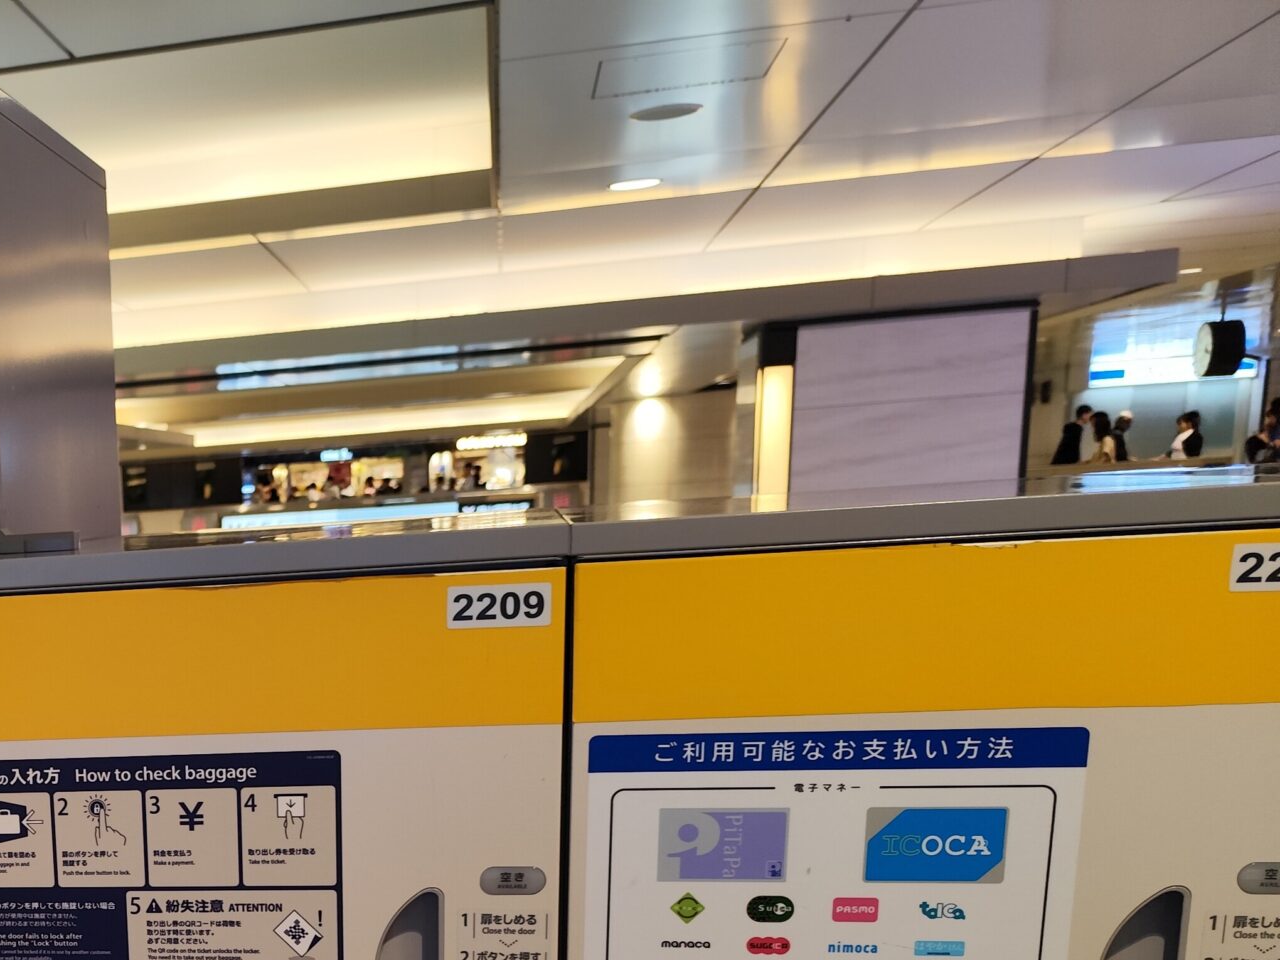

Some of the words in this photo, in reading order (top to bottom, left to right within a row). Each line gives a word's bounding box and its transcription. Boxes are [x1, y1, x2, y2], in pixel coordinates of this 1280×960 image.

[452, 590, 545, 621] 2209
[654, 737, 1015, 763] ご利用可能なお支払い方法
[75, 768, 111, 783] How
[114, 768, 131, 782] to
[135, 766, 181, 781] check
[185, 765, 257, 783] baggage
[793, 783, 861, 793] 電子マネー
[57, 799, 69, 815] 2
[150, 797, 161, 814] 3
[244, 794, 257, 812] 4
[153, 849, 192, 857] 料金を支払う
[248, 848, 316, 856] 取り出し券を受け取る
[723, 815, 743, 879] PiTaPa
[880, 834, 992, 857] ICOCA
[500, 872, 525, 883] 空き
[130, 897, 141, 914] 5
[166, 899, 224, 913] 紛失注意
[228, 903, 283, 912] ATTENTION
[836, 905, 875, 914] PASMO
[461, 913, 468, 926] 1
[480, 914, 537, 925] 扉をしめる
[1209, 915, 1217, 930] 1
[482, 927, 502, 935] Close
[503, 927, 517, 935] the
[518, 927, 536, 935] door
[661, 940, 711, 949] manaca
[828, 942, 878, 953] nimoca
